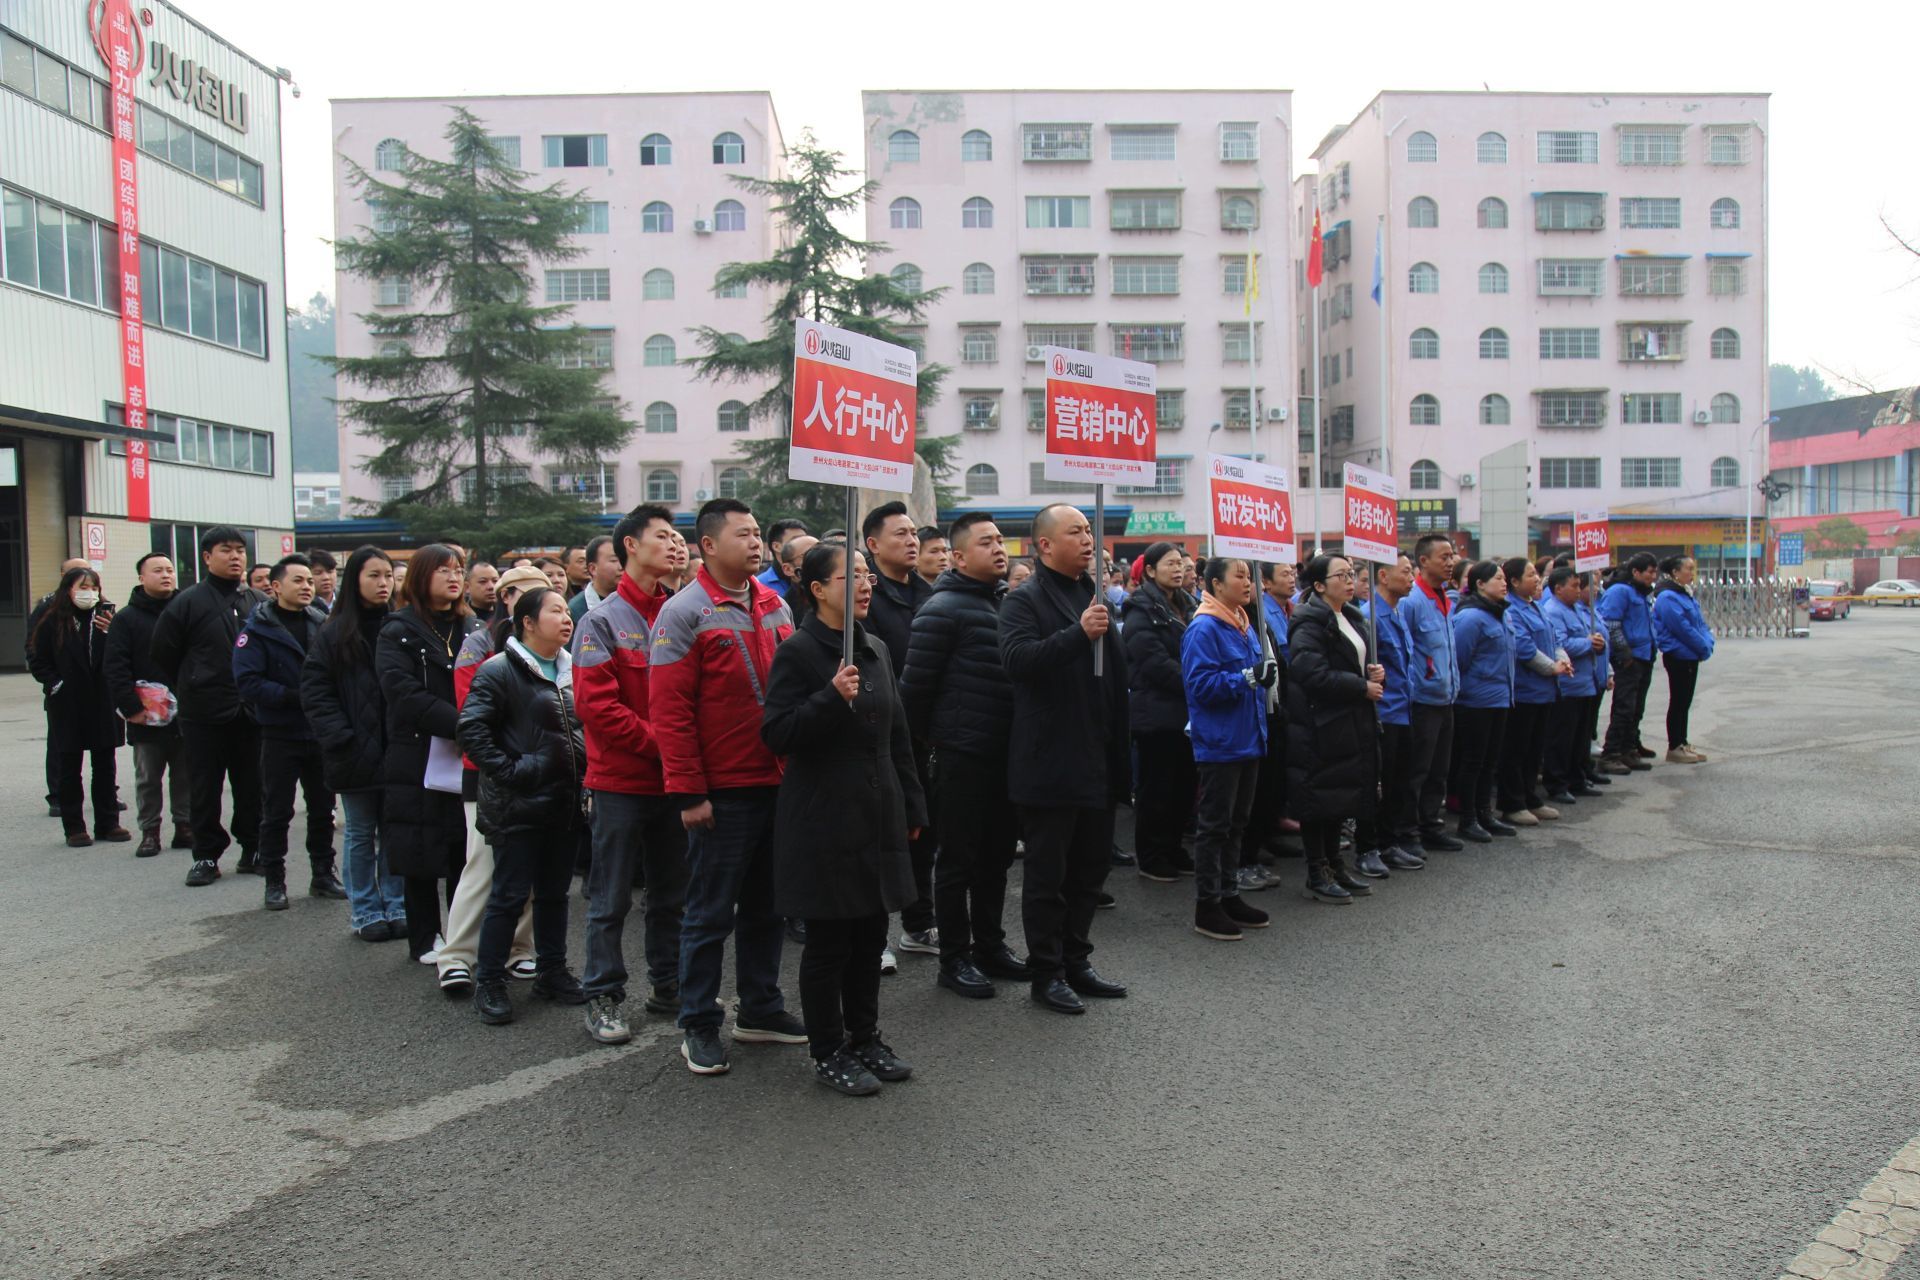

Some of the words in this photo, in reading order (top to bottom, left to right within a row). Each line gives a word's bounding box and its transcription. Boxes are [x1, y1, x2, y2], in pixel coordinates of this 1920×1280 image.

[114, 44, 133, 143] 奋力拼搏
[150, 40, 248, 135] 火焰山
[118, 157, 138, 255] 团结协作
[123, 271, 142, 368] 知难而进
[820, 339, 851, 361] 火焰山
[1066, 361, 1093, 379] 火焰山
[128, 384, 145, 480] 志在必得
[803, 380, 909, 445] 人行中心
[1054, 395, 1150, 446] 营销中心
[1217, 492, 1287, 531] 研发中心
[1348, 496, 1394, 535] 财务中心
[1577, 527, 1607, 552] 生产中心
